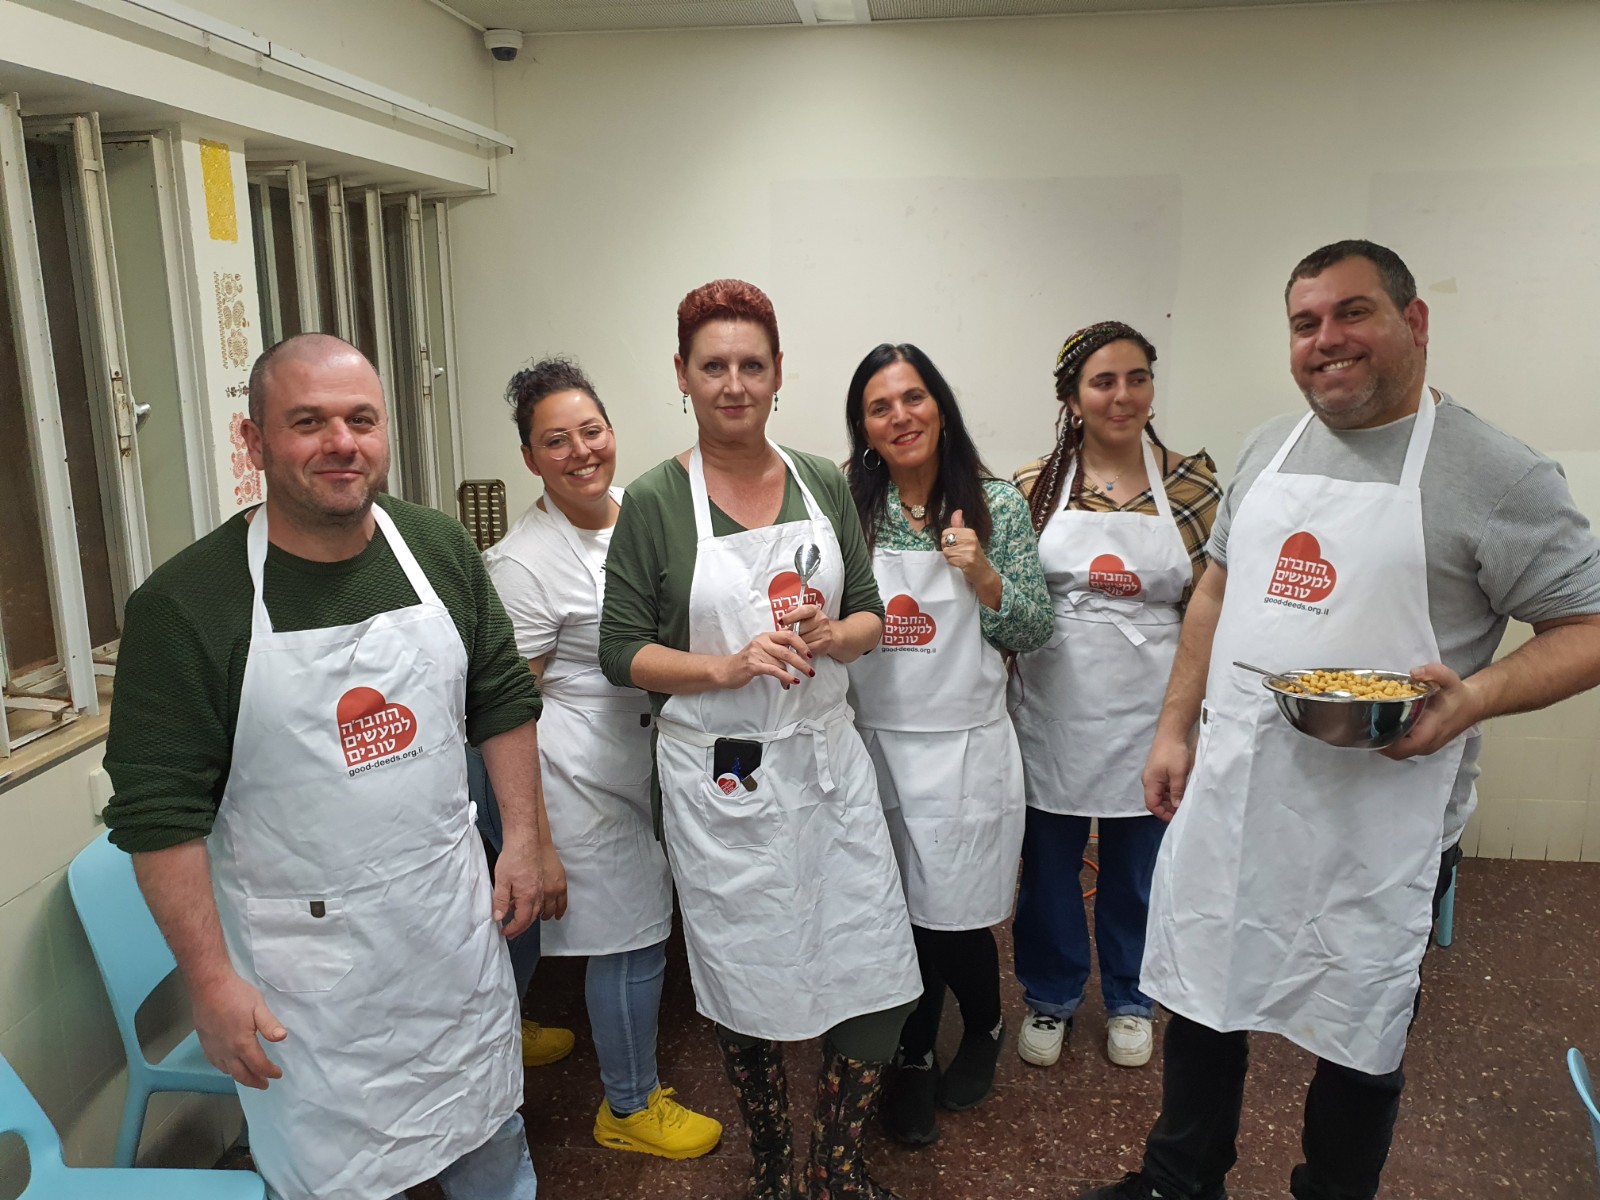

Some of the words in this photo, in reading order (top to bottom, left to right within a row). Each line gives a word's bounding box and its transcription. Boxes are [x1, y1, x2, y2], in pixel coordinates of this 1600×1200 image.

[1275, 569, 1332, 590] למעשים
[1271, 582, 1311, 599] טובים
[1263, 597, 1330, 616] good-deeds.org.il
[885, 623, 933, 635] למעשים
[884, 635, 919, 644] טובים
[343, 716, 411, 749] למעשים
[346, 738, 397, 763] טובים
[348, 745, 424, 777] good-deeds.org.il
